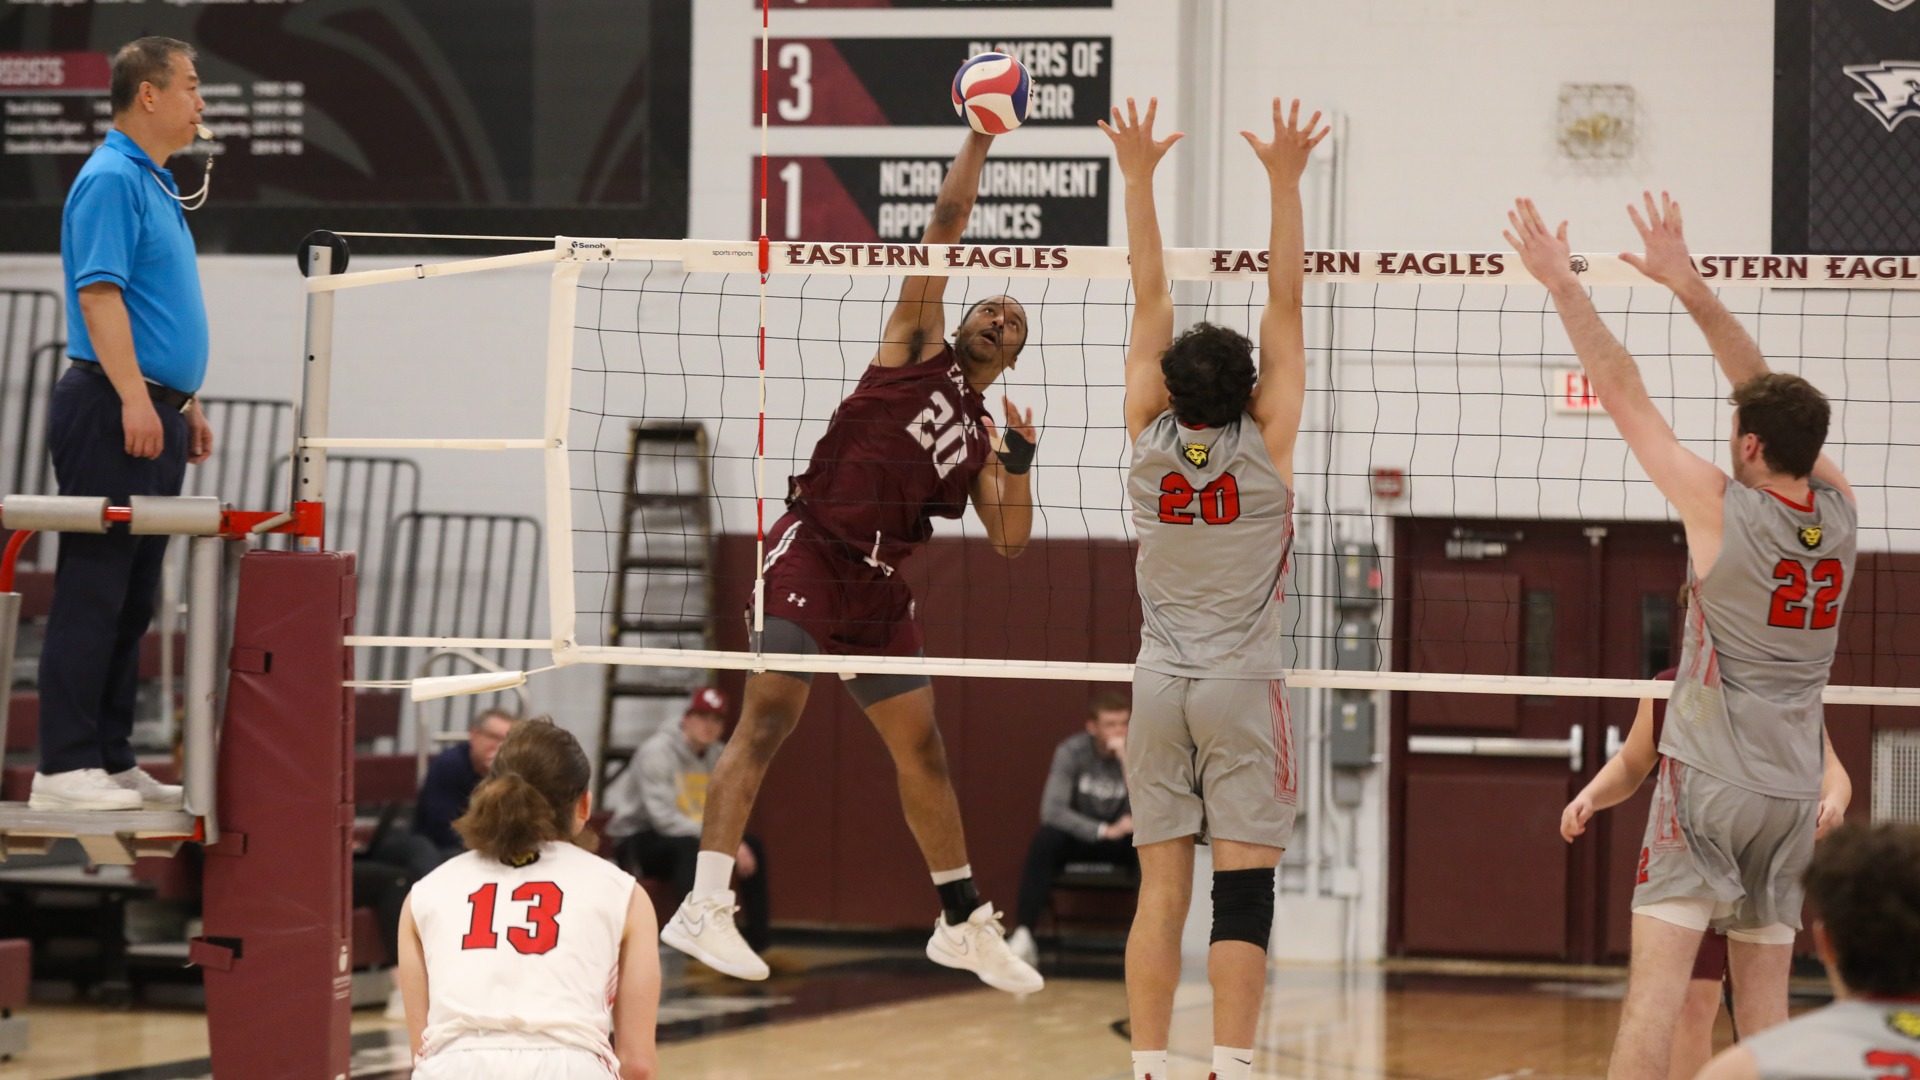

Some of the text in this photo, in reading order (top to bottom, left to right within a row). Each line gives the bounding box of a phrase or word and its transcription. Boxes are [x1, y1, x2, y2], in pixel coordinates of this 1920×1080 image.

[1072, 42, 1103, 77] OF
[778, 43, 812, 121] 3
[1030, 84, 1074, 119] EAR
[880, 161, 1101, 197] NCAA URNAMENT
[779, 161, 801, 240] 1
[879, 202, 1042, 239] APPANCES
[731, 250, 754, 258] imports
[787, 244, 1069, 270] EASTERN EAGLES
[1212, 250, 1505, 275] EASERN EAGLES
[1690, 256, 1808, 278] STERN
[905, 391, 968, 479] 20
[1158, 471, 1241, 525] 20
[1767, 558, 1845, 630] 22
[461, 881, 564, 955] 13
